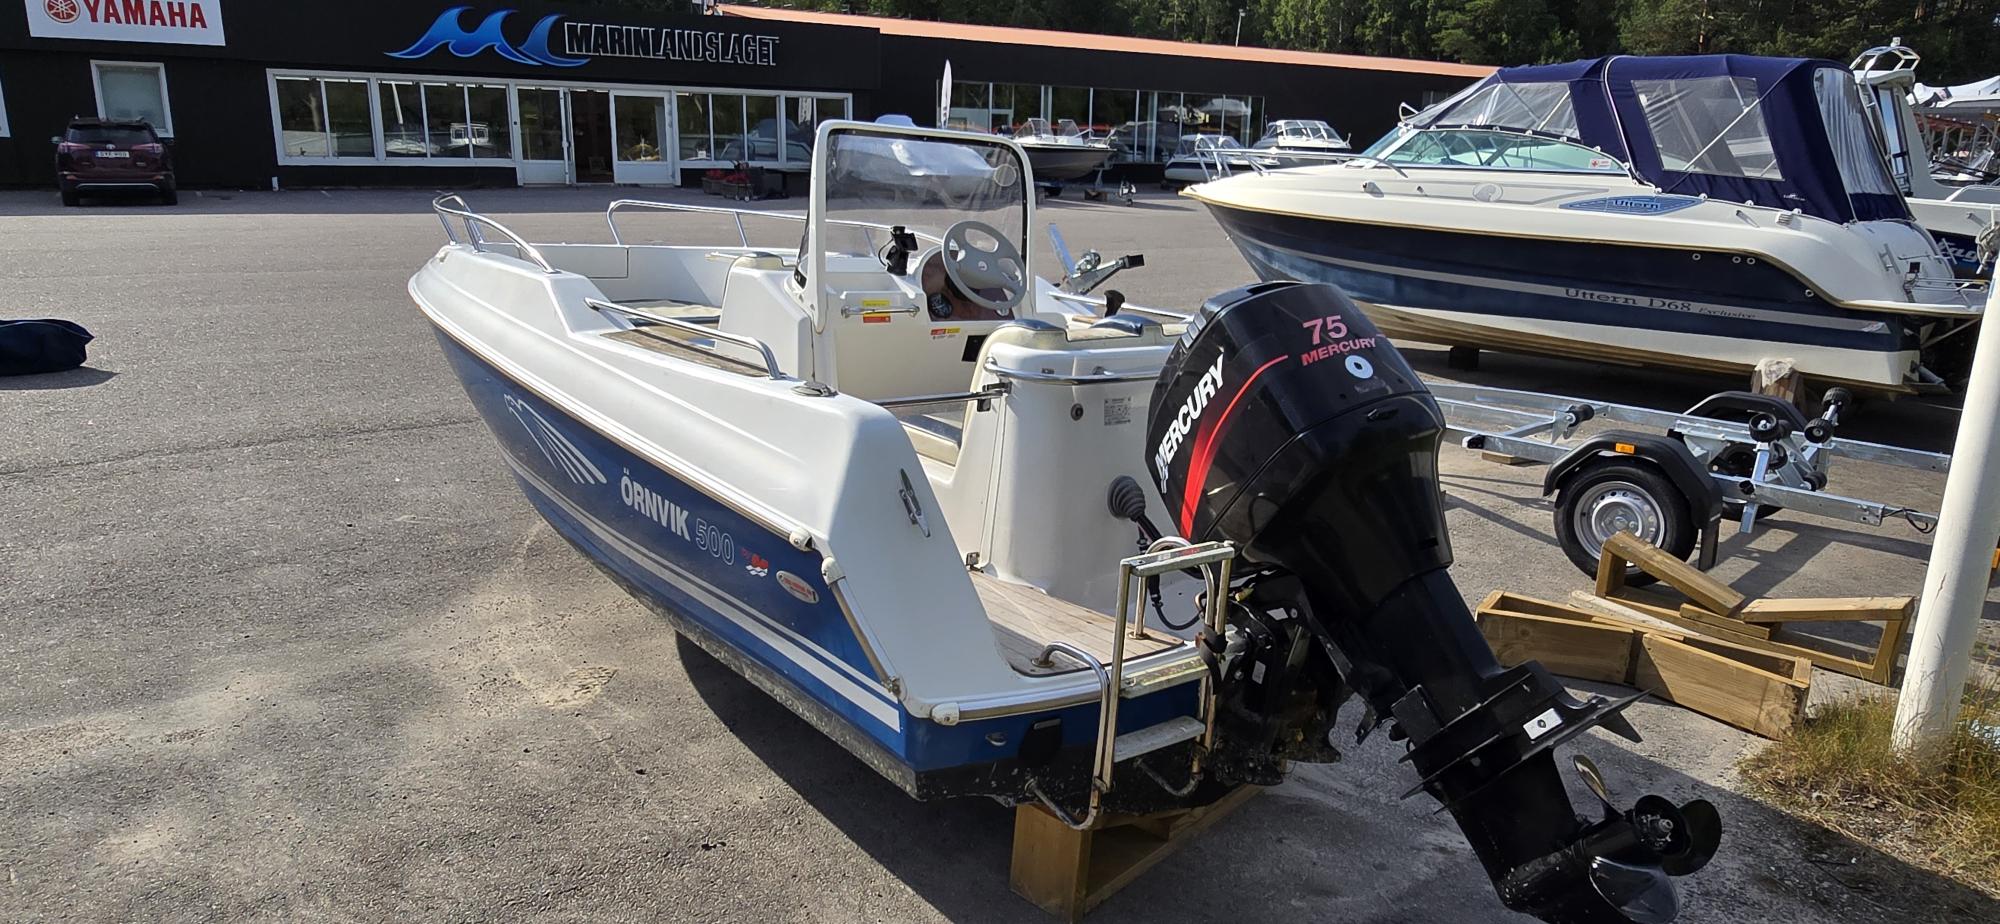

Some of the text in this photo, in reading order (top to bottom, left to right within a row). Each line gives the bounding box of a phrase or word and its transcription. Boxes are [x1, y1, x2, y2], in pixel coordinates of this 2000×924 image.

[84, 0, 208, 29] YAMAHA
[564, 22, 780, 66] MARINLANDSLAGET
[1565, 288, 1637, 306] Uttern
[1649, 298, 1692, 312] D68
[1302, 315, 1348, 345] 75
[1301, 337, 1377, 366] MERCURY
[1155, 354, 1224, 480] MERCURY
[620, 467, 735, 566] ÖRNVIK 500
